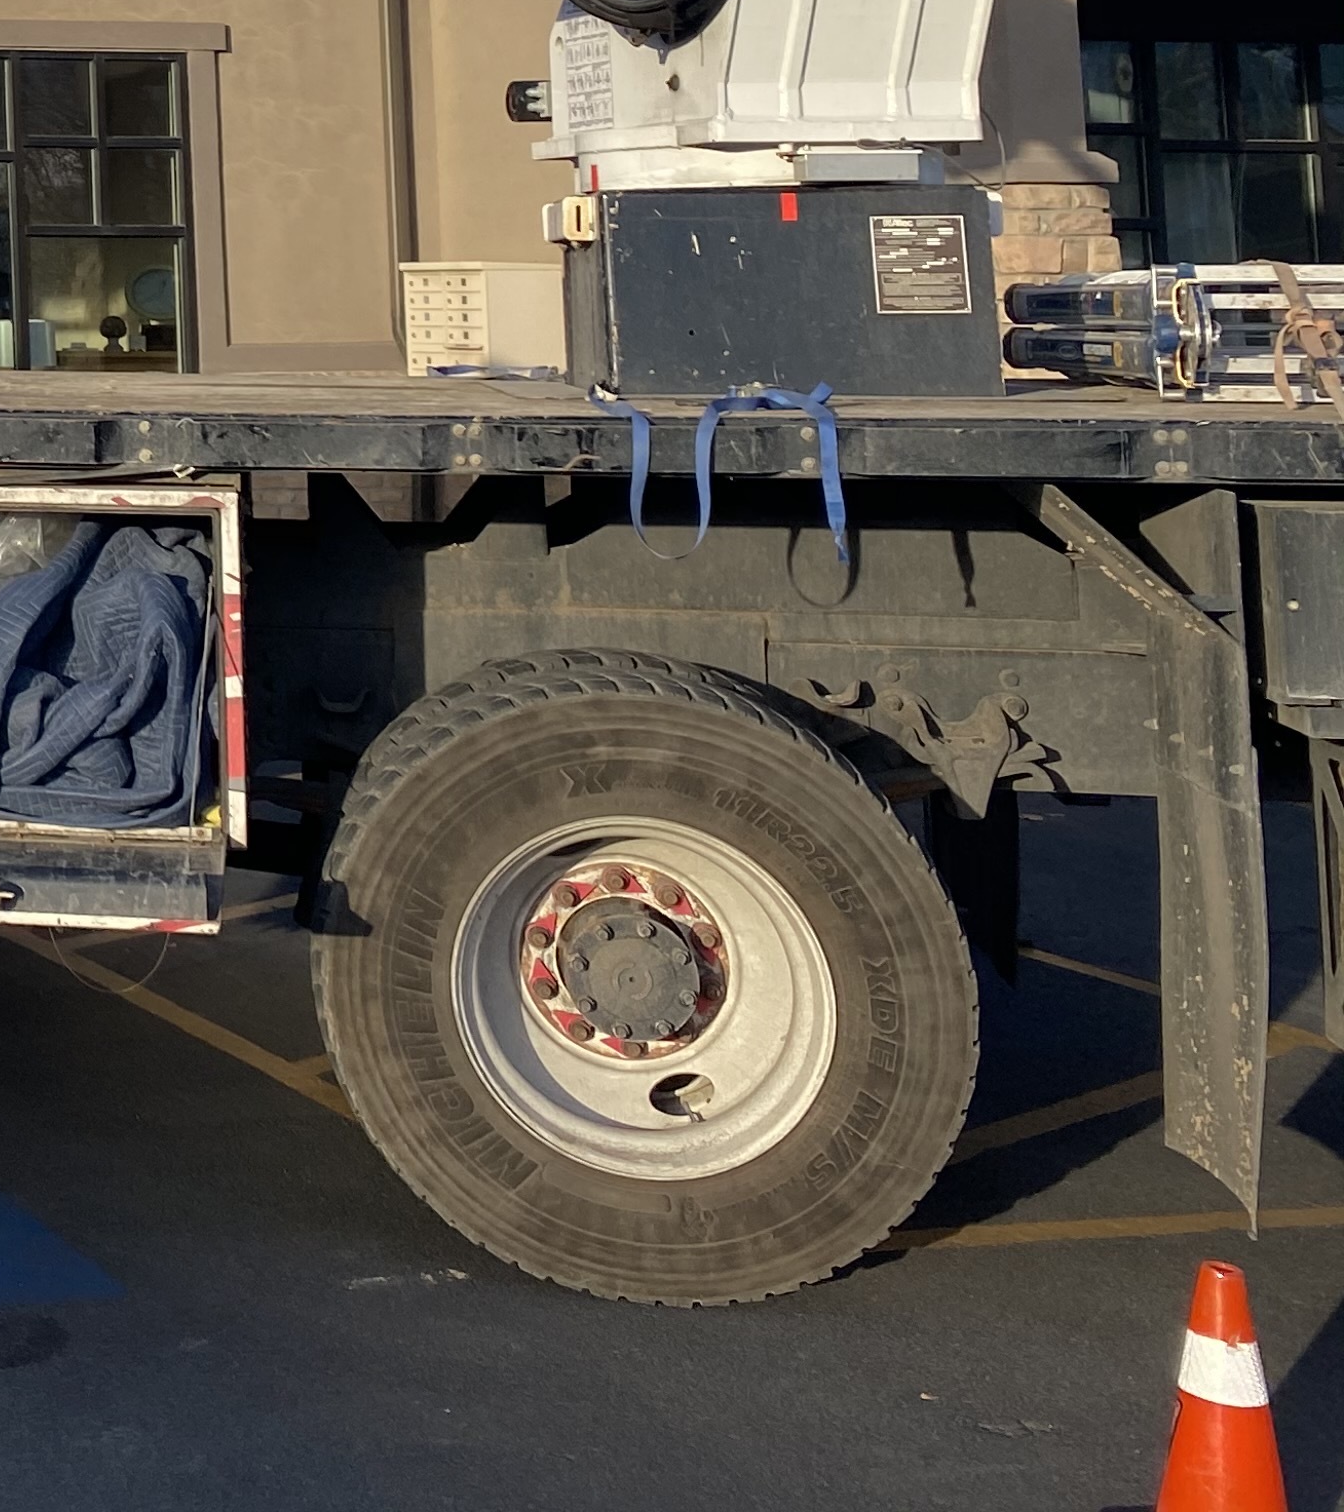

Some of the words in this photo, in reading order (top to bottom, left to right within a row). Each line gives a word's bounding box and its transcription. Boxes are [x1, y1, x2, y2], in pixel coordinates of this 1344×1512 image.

[713, 787, 864, 915] 11R22.5
[389, 892, 543, 1189] MICHELIN
[859, 955, 900, 1073] XDE
[803, 1089, 890, 1190] M/S
